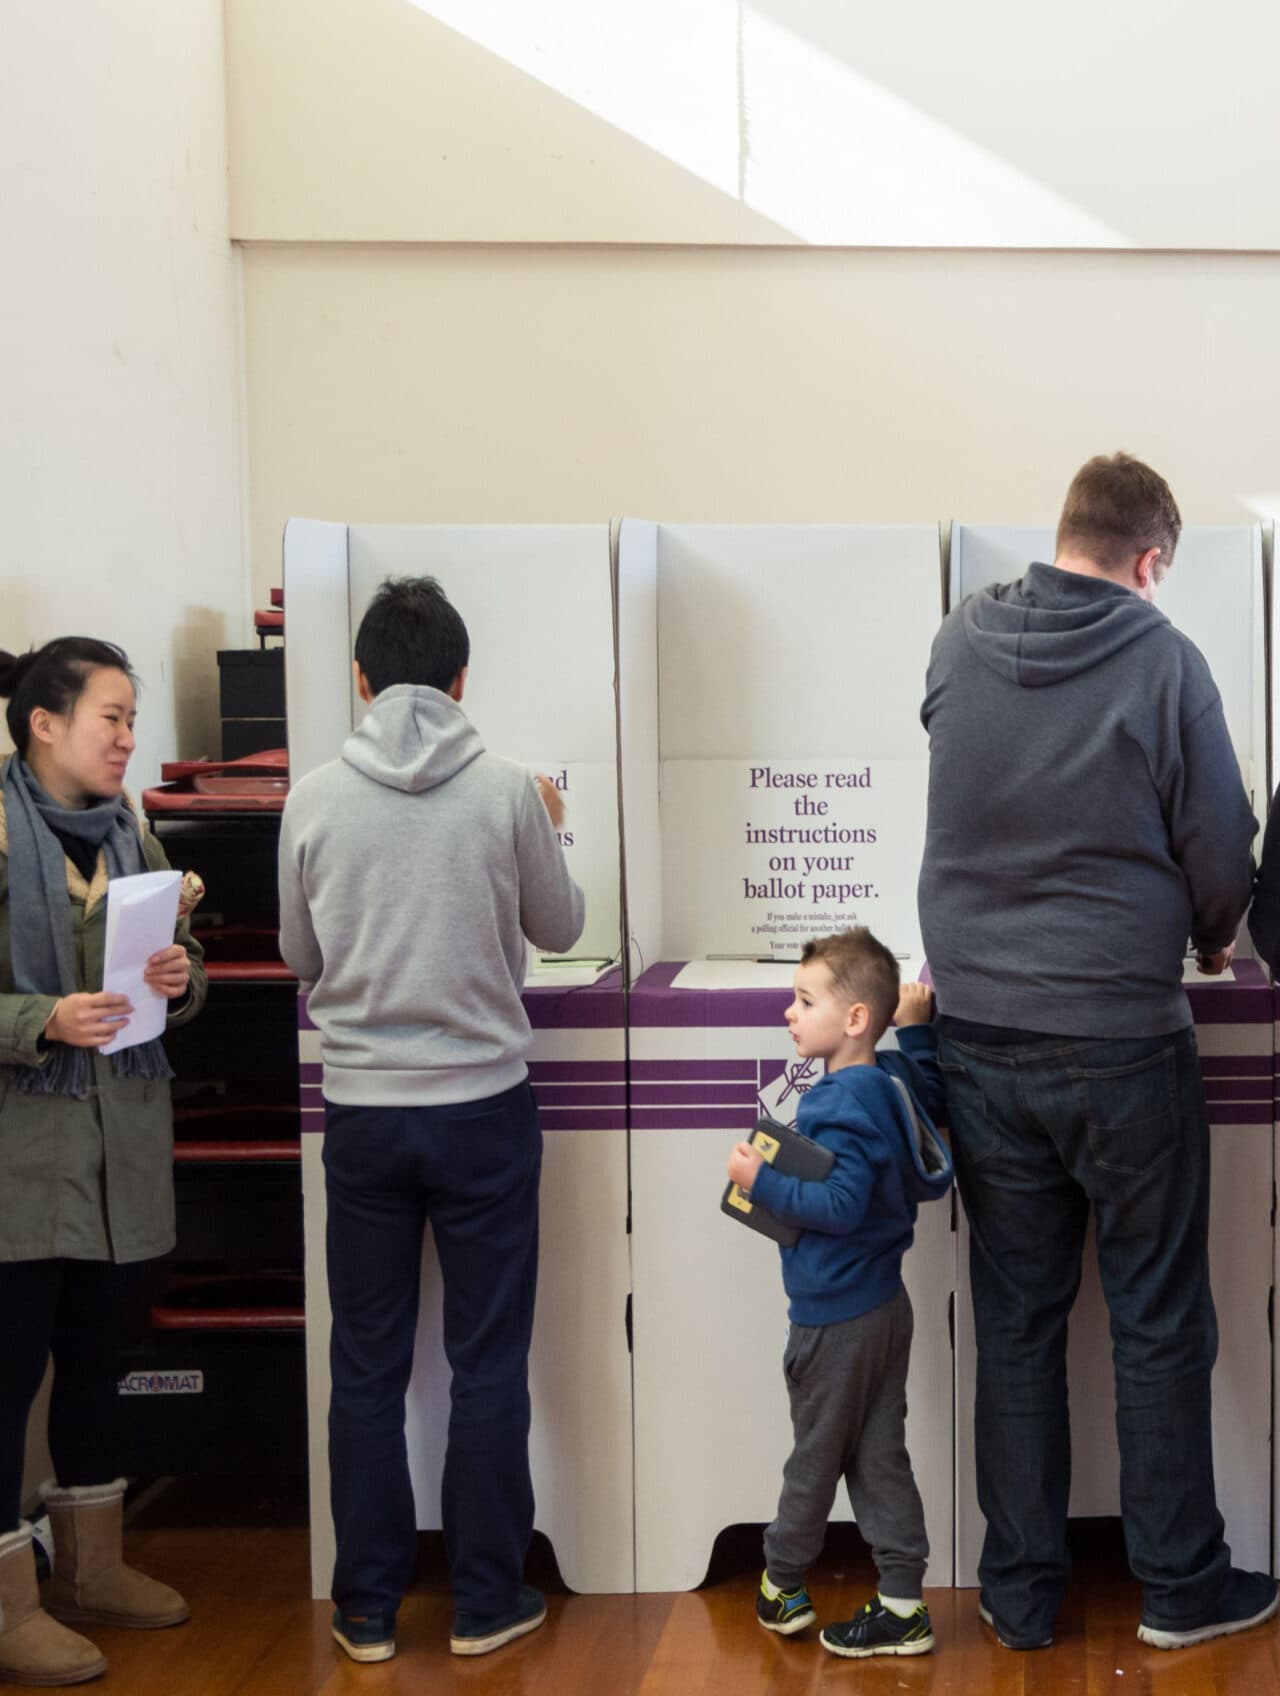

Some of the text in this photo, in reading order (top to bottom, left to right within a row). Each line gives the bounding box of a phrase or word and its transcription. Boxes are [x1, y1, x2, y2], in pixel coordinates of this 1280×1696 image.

[749, 767, 872, 789] Please read
[794, 795, 829, 816] the
[745, 822, 877, 844] instructions
[769, 856, 855, 876] on your
[743, 878, 880, 904] ballot paper.
